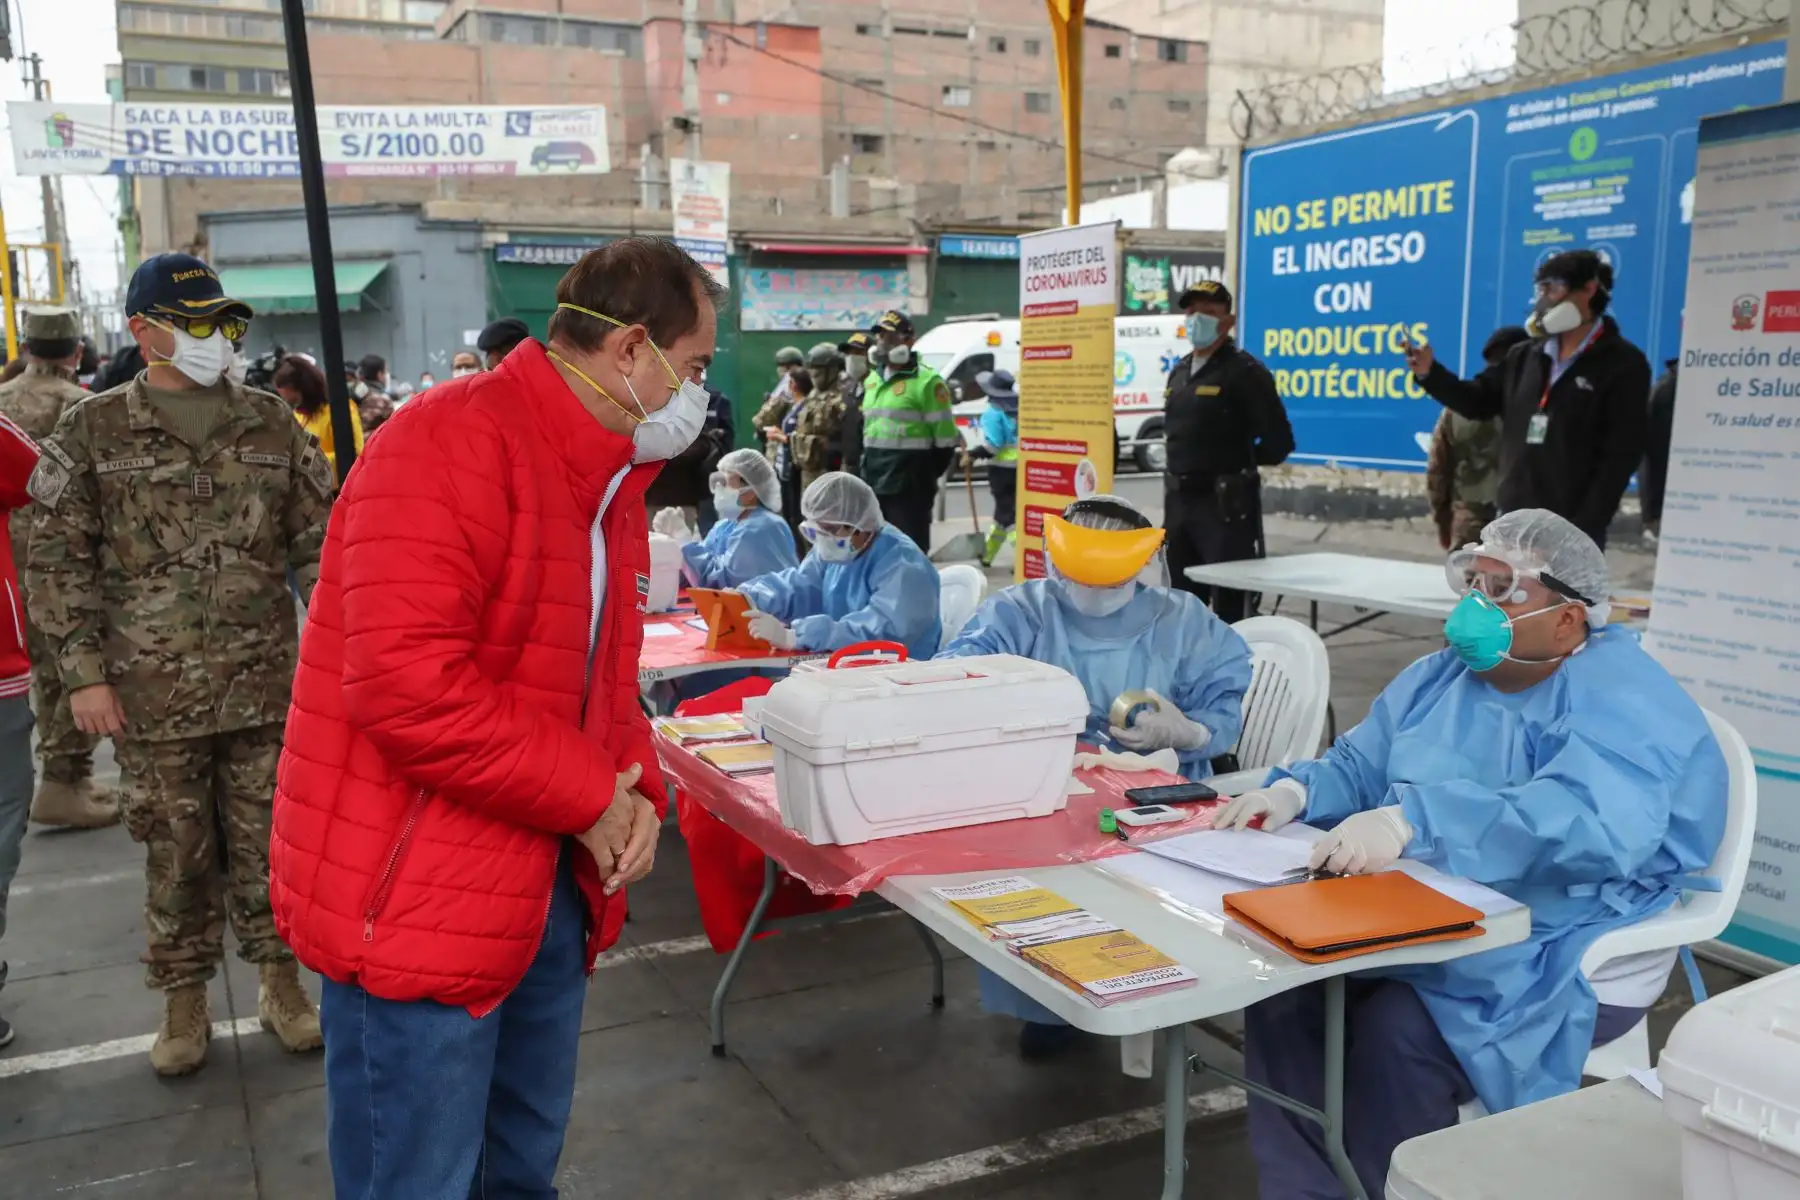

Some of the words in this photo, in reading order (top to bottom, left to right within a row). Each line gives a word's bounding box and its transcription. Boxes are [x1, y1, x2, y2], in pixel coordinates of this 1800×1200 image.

[125, 108, 180, 125] SACA
[188, 108, 213, 126] LA
[336, 112, 386, 129] EVITA
[395, 112, 419, 128] LA
[125, 129, 173, 155] DE
[186, 129, 300, 156] NOCHE
[341, 132, 485, 157] S/2100.00
[1254, 205, 1290, 237] NO
[1295, 199, 1326, 232] SE
[1332, 179, 1455, 227] PERMITE
[1027, 248, 1083, 271] PROTÉGETE
[1086, 246, 1105, 263] DEL
[1272, 245, 1300, 275] EL
[1305, 231, 1425, 272] INGRESO
[1025, 266, 1107, 292] CORONAVIRUS
[1314, 280, 1372, 314] CON
[1264, 322, 1428, 357] PRODUCTOS
[1685, 346, 1770, 368] Dirección
[1778, 344, 1800, 367] de
[1718, 377, 1741, 397] de
[1730, 412, 1774, 427] salud
[1776, 416, 1792, 427] es
